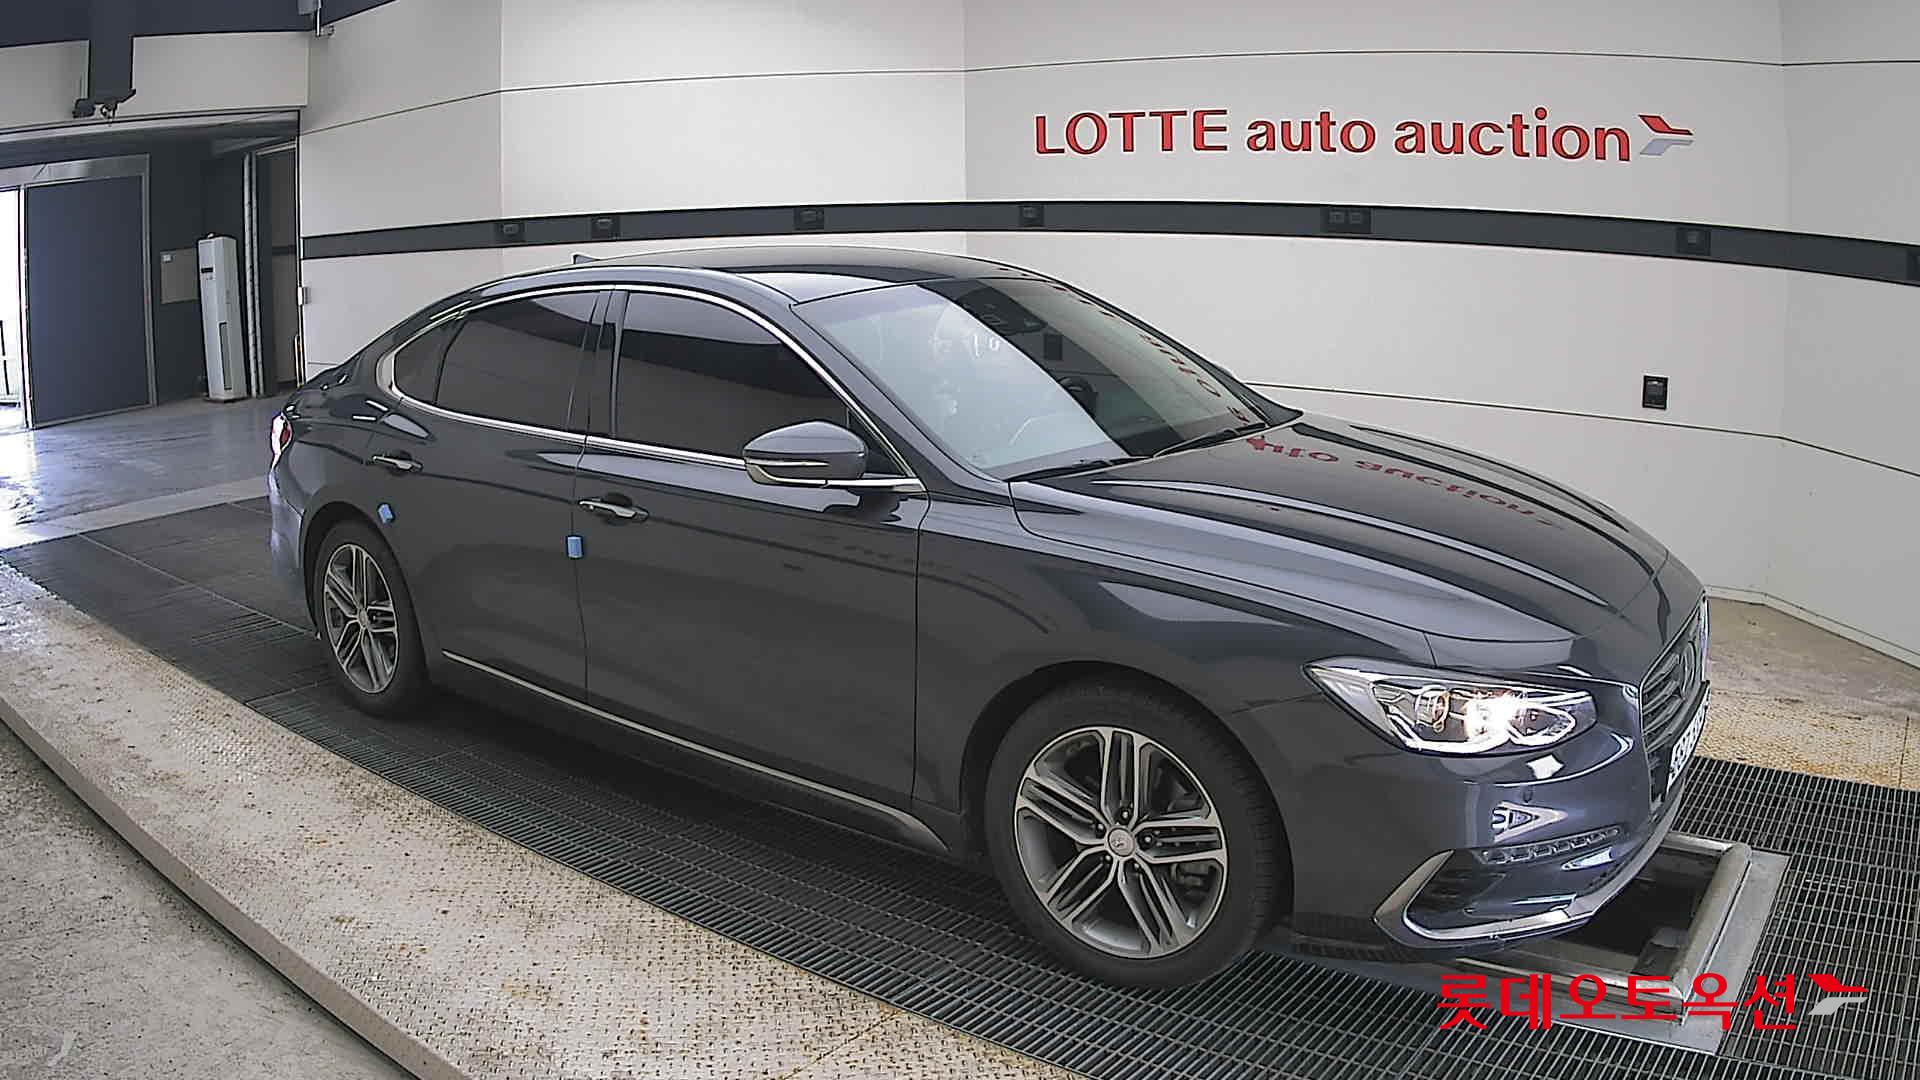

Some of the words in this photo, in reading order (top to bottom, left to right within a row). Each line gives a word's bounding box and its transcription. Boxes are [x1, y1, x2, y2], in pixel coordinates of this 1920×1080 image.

[1035, 109, 1228, 155] LOTTE
[1246, 110, 1376, 153] auto
[1394, 106, 1631, 162] auction
